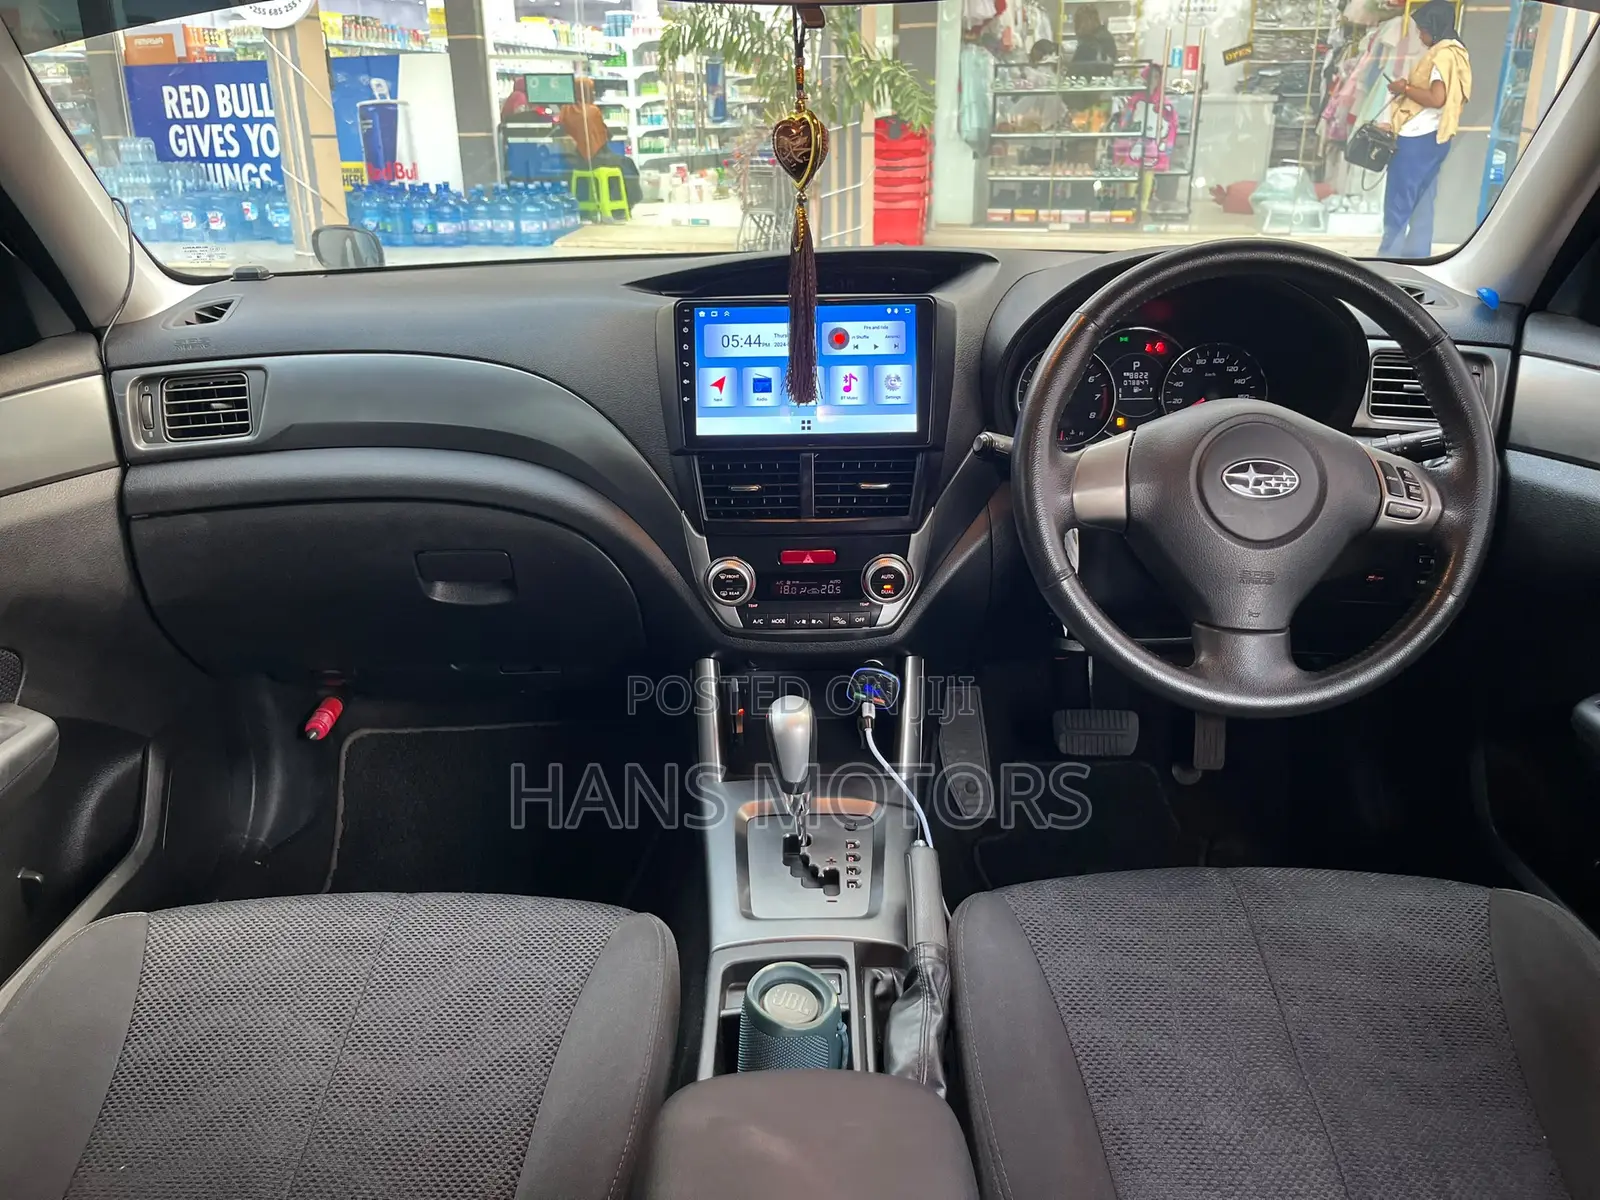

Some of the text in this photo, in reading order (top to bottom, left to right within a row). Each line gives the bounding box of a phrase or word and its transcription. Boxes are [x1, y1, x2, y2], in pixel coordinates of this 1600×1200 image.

[162, 82, 275, 119] RED BULL
[168, 122, 281, 158] GIVES YO
[721, 334, 761, 349] 05:44
[1132, 361, 1141, 371] P
[1088, 375, 1095, 383] 6
[1088, 411, 1097, 419] 8
[772, 988, 812, 1016] JBL
